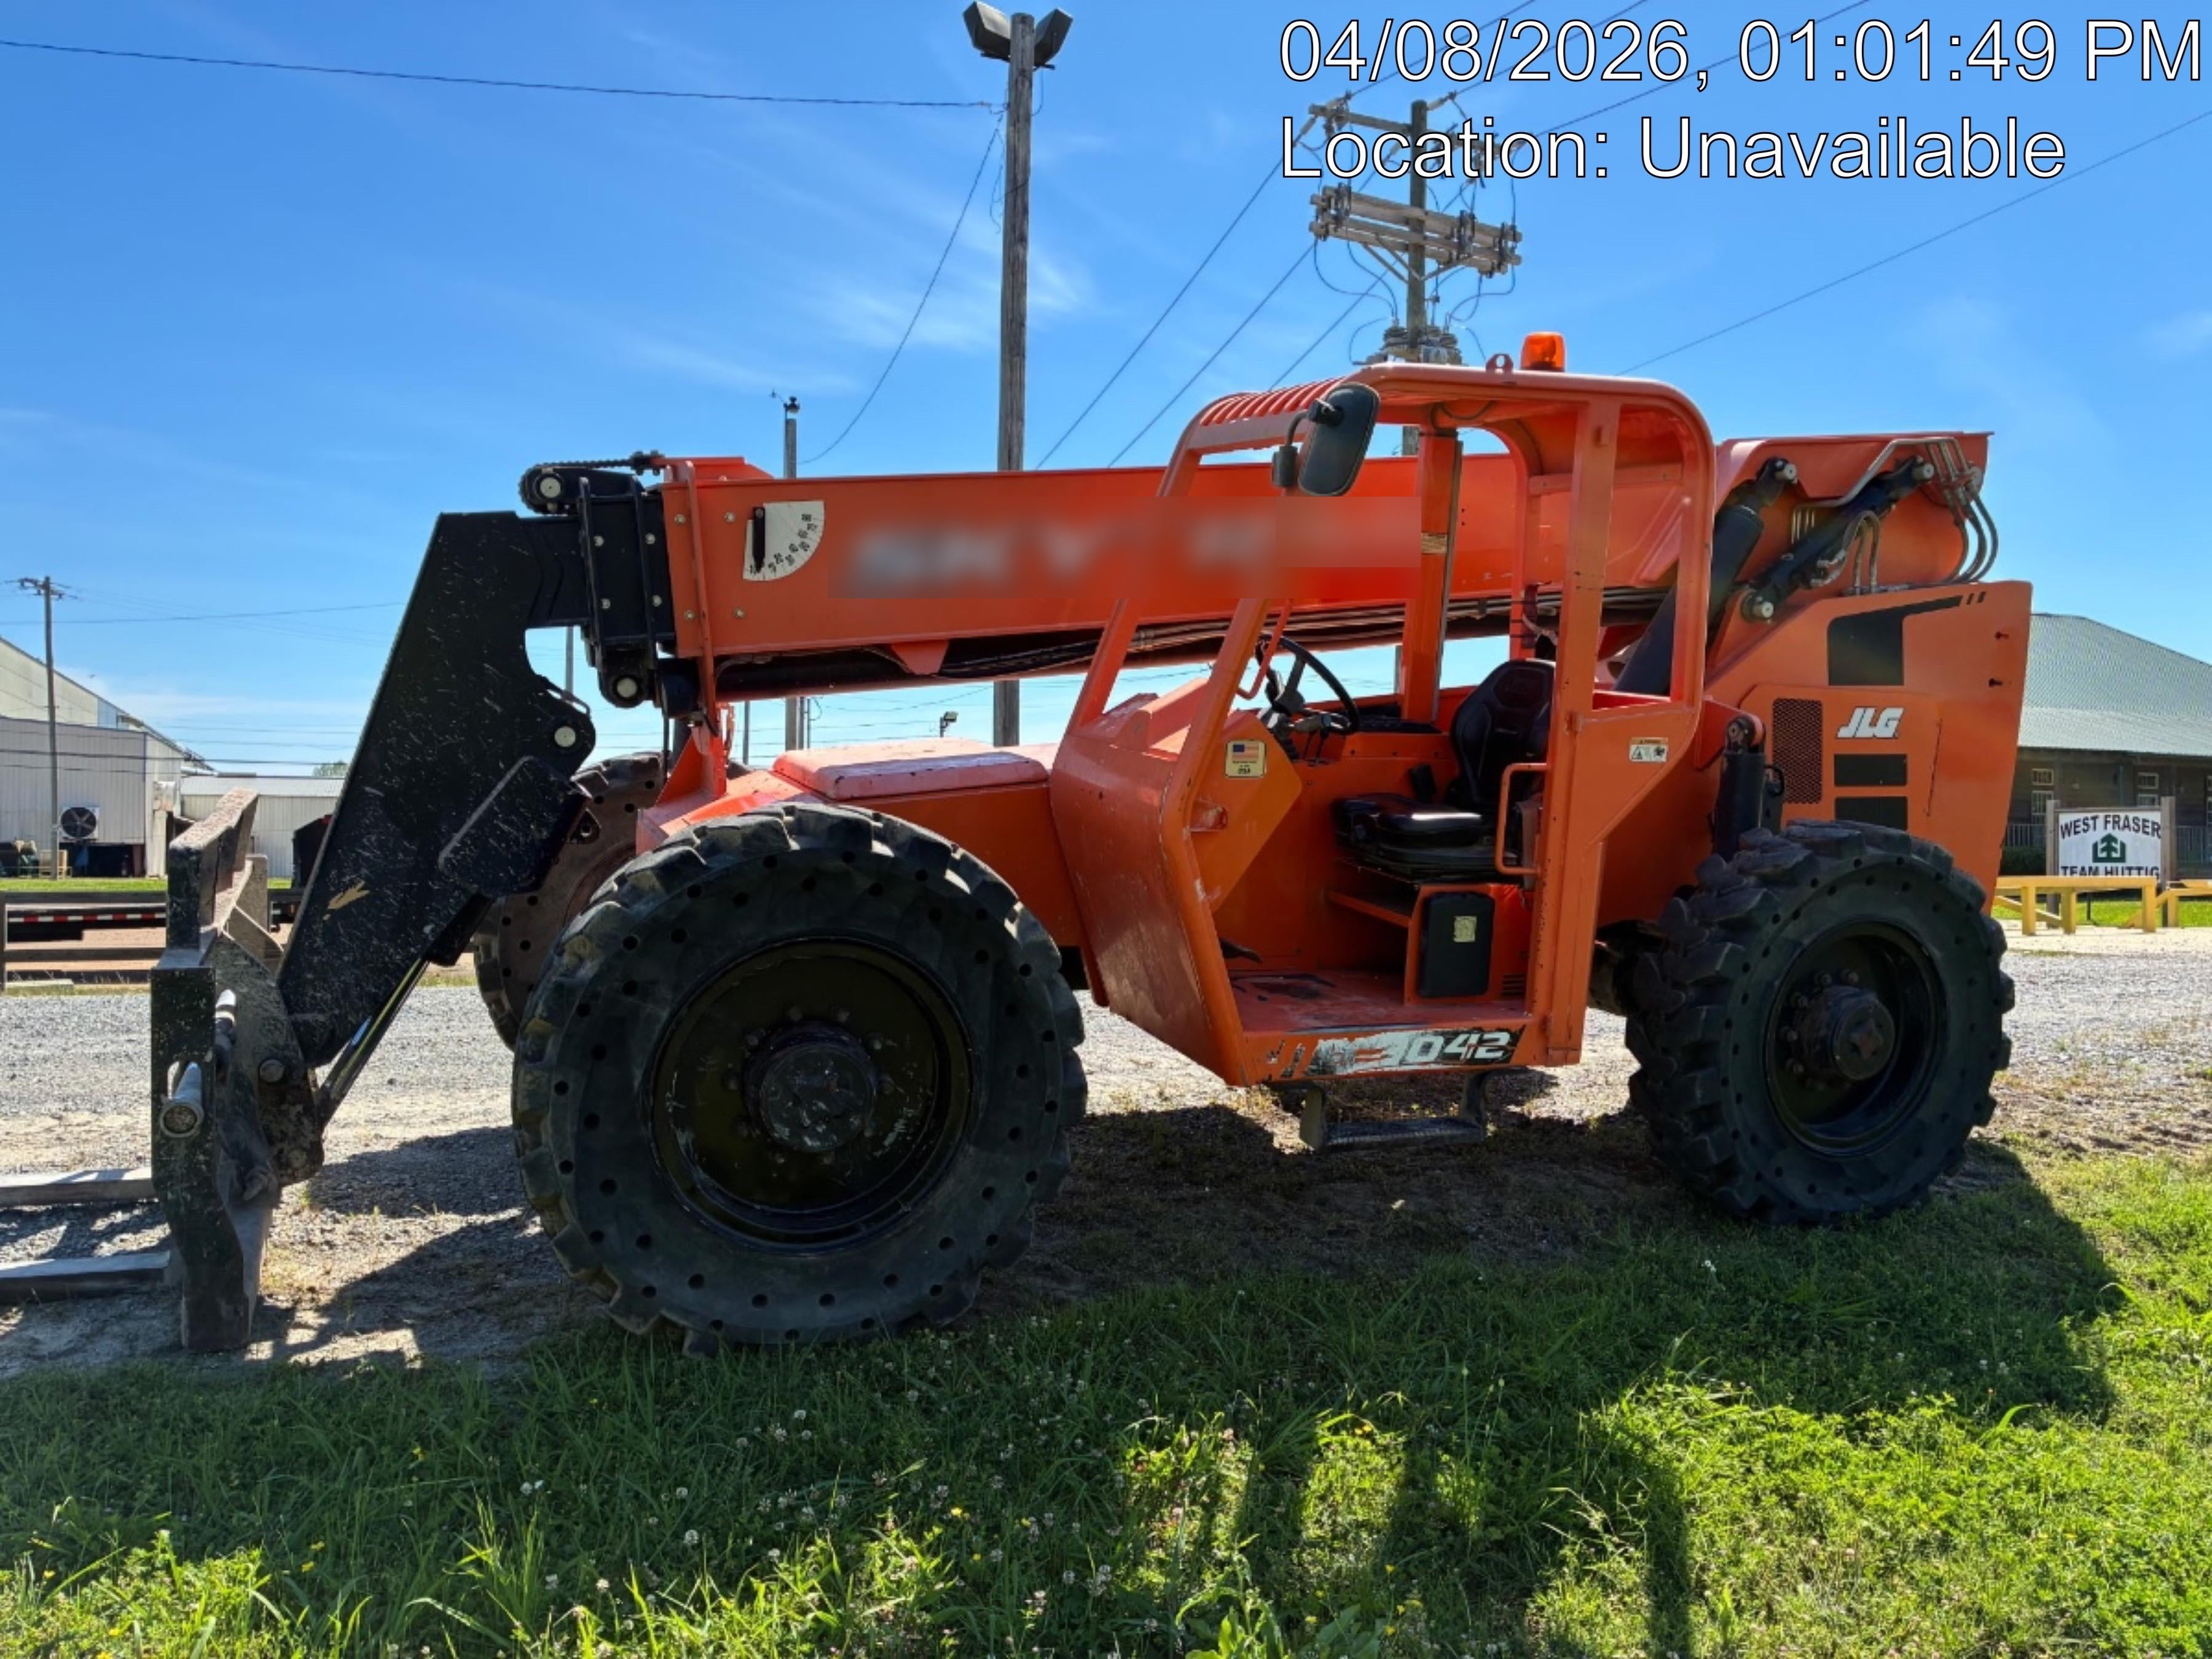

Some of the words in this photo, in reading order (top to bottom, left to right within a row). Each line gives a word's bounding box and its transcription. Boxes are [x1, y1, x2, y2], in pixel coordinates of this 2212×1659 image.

[1836, 707, 1904, 739] JLG
[2060, 815, 2099, 839] WEST
[2104, 814, 2162, 839] FRASER
[2060, 866, 2100, 876] TEAM
